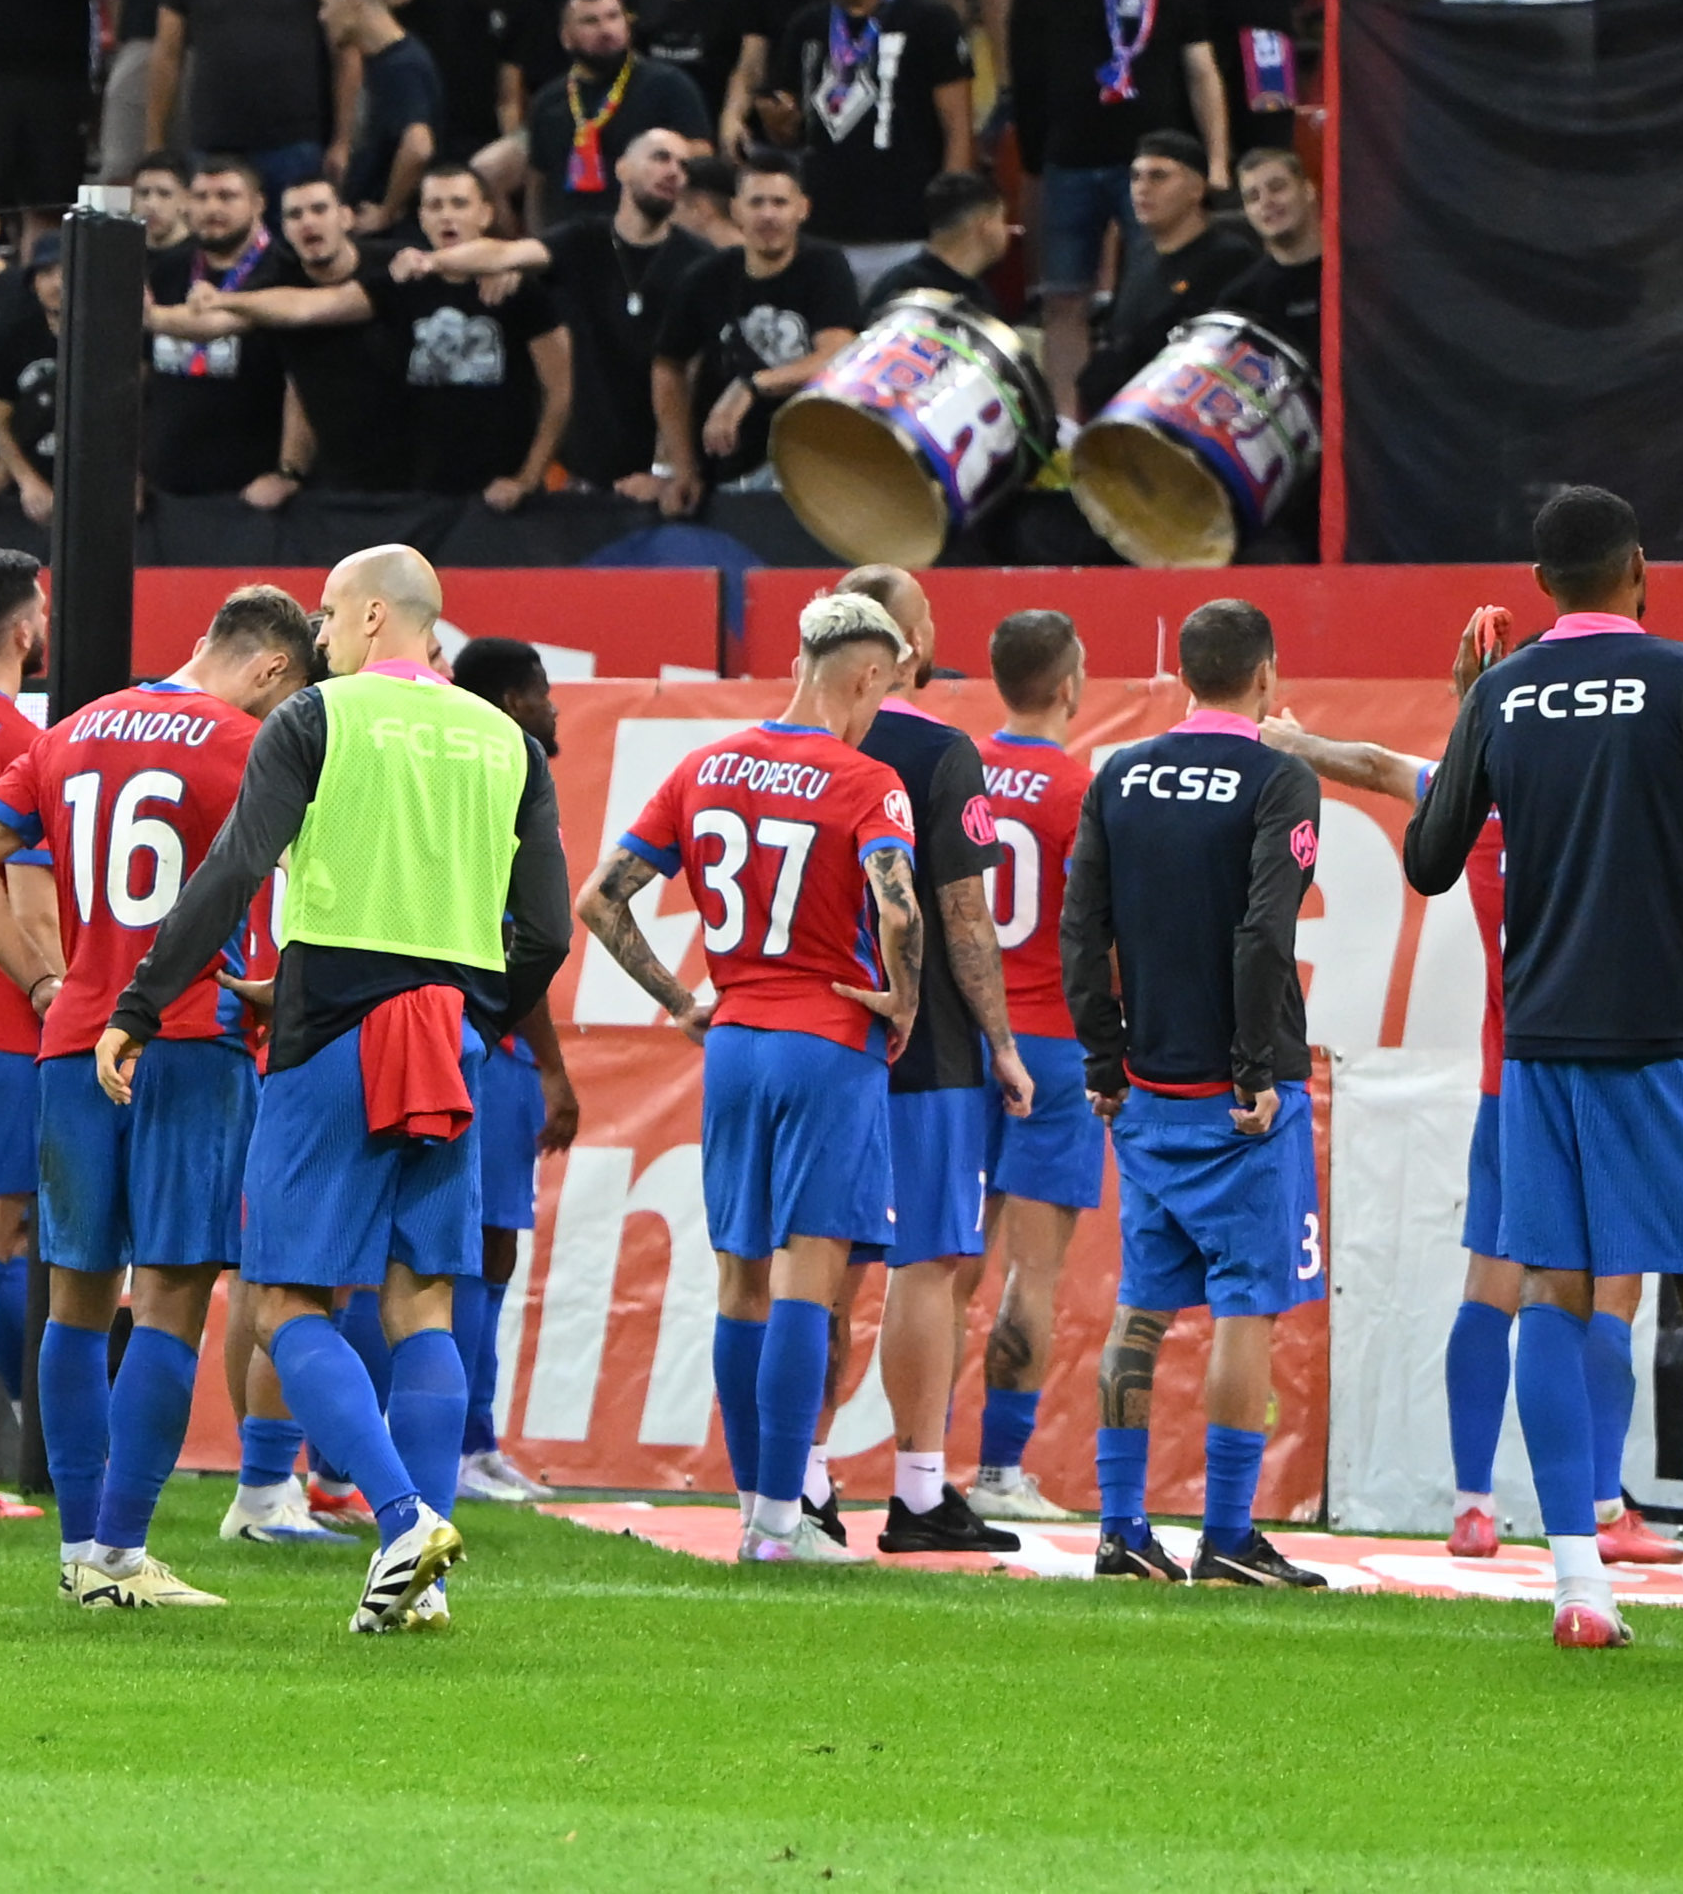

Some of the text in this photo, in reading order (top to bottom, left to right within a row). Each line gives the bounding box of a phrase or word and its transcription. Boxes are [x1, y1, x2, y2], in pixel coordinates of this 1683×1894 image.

[1499, 678, 1646, 724] FCSB
[68, 707, 218, 749] LIXANDRU
[369, 717, 513, 772] FCSB
[696, 752, 831, 801] OCT.POPESCU
[1120, 761, 1244, 804] FCSB
[62, 767, 187, 931] 16
[692, 808, 818, 957] 37
